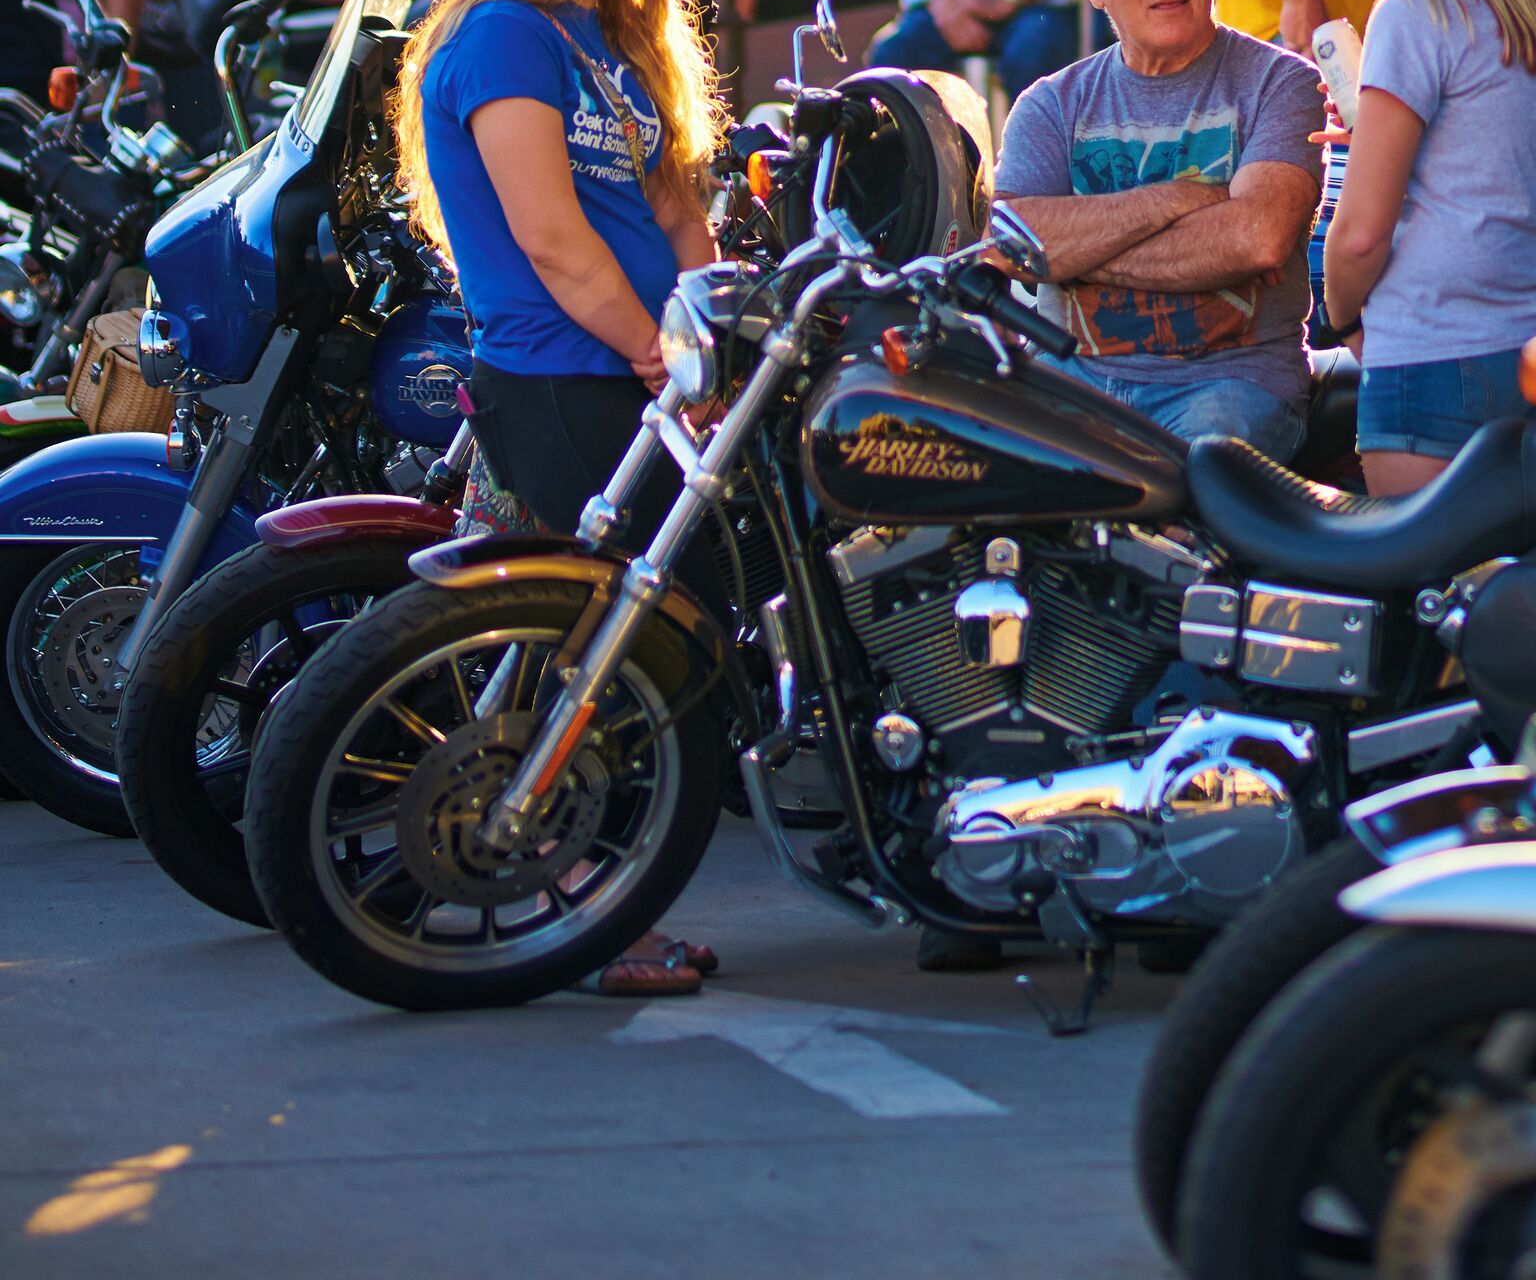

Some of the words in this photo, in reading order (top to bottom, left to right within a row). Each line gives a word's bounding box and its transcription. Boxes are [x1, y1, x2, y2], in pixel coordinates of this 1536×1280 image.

[573, 110, 604, 132] Oak
[567, 127, 603, 150] Joint
[863, 456, 989, 481] DAVIDSON
